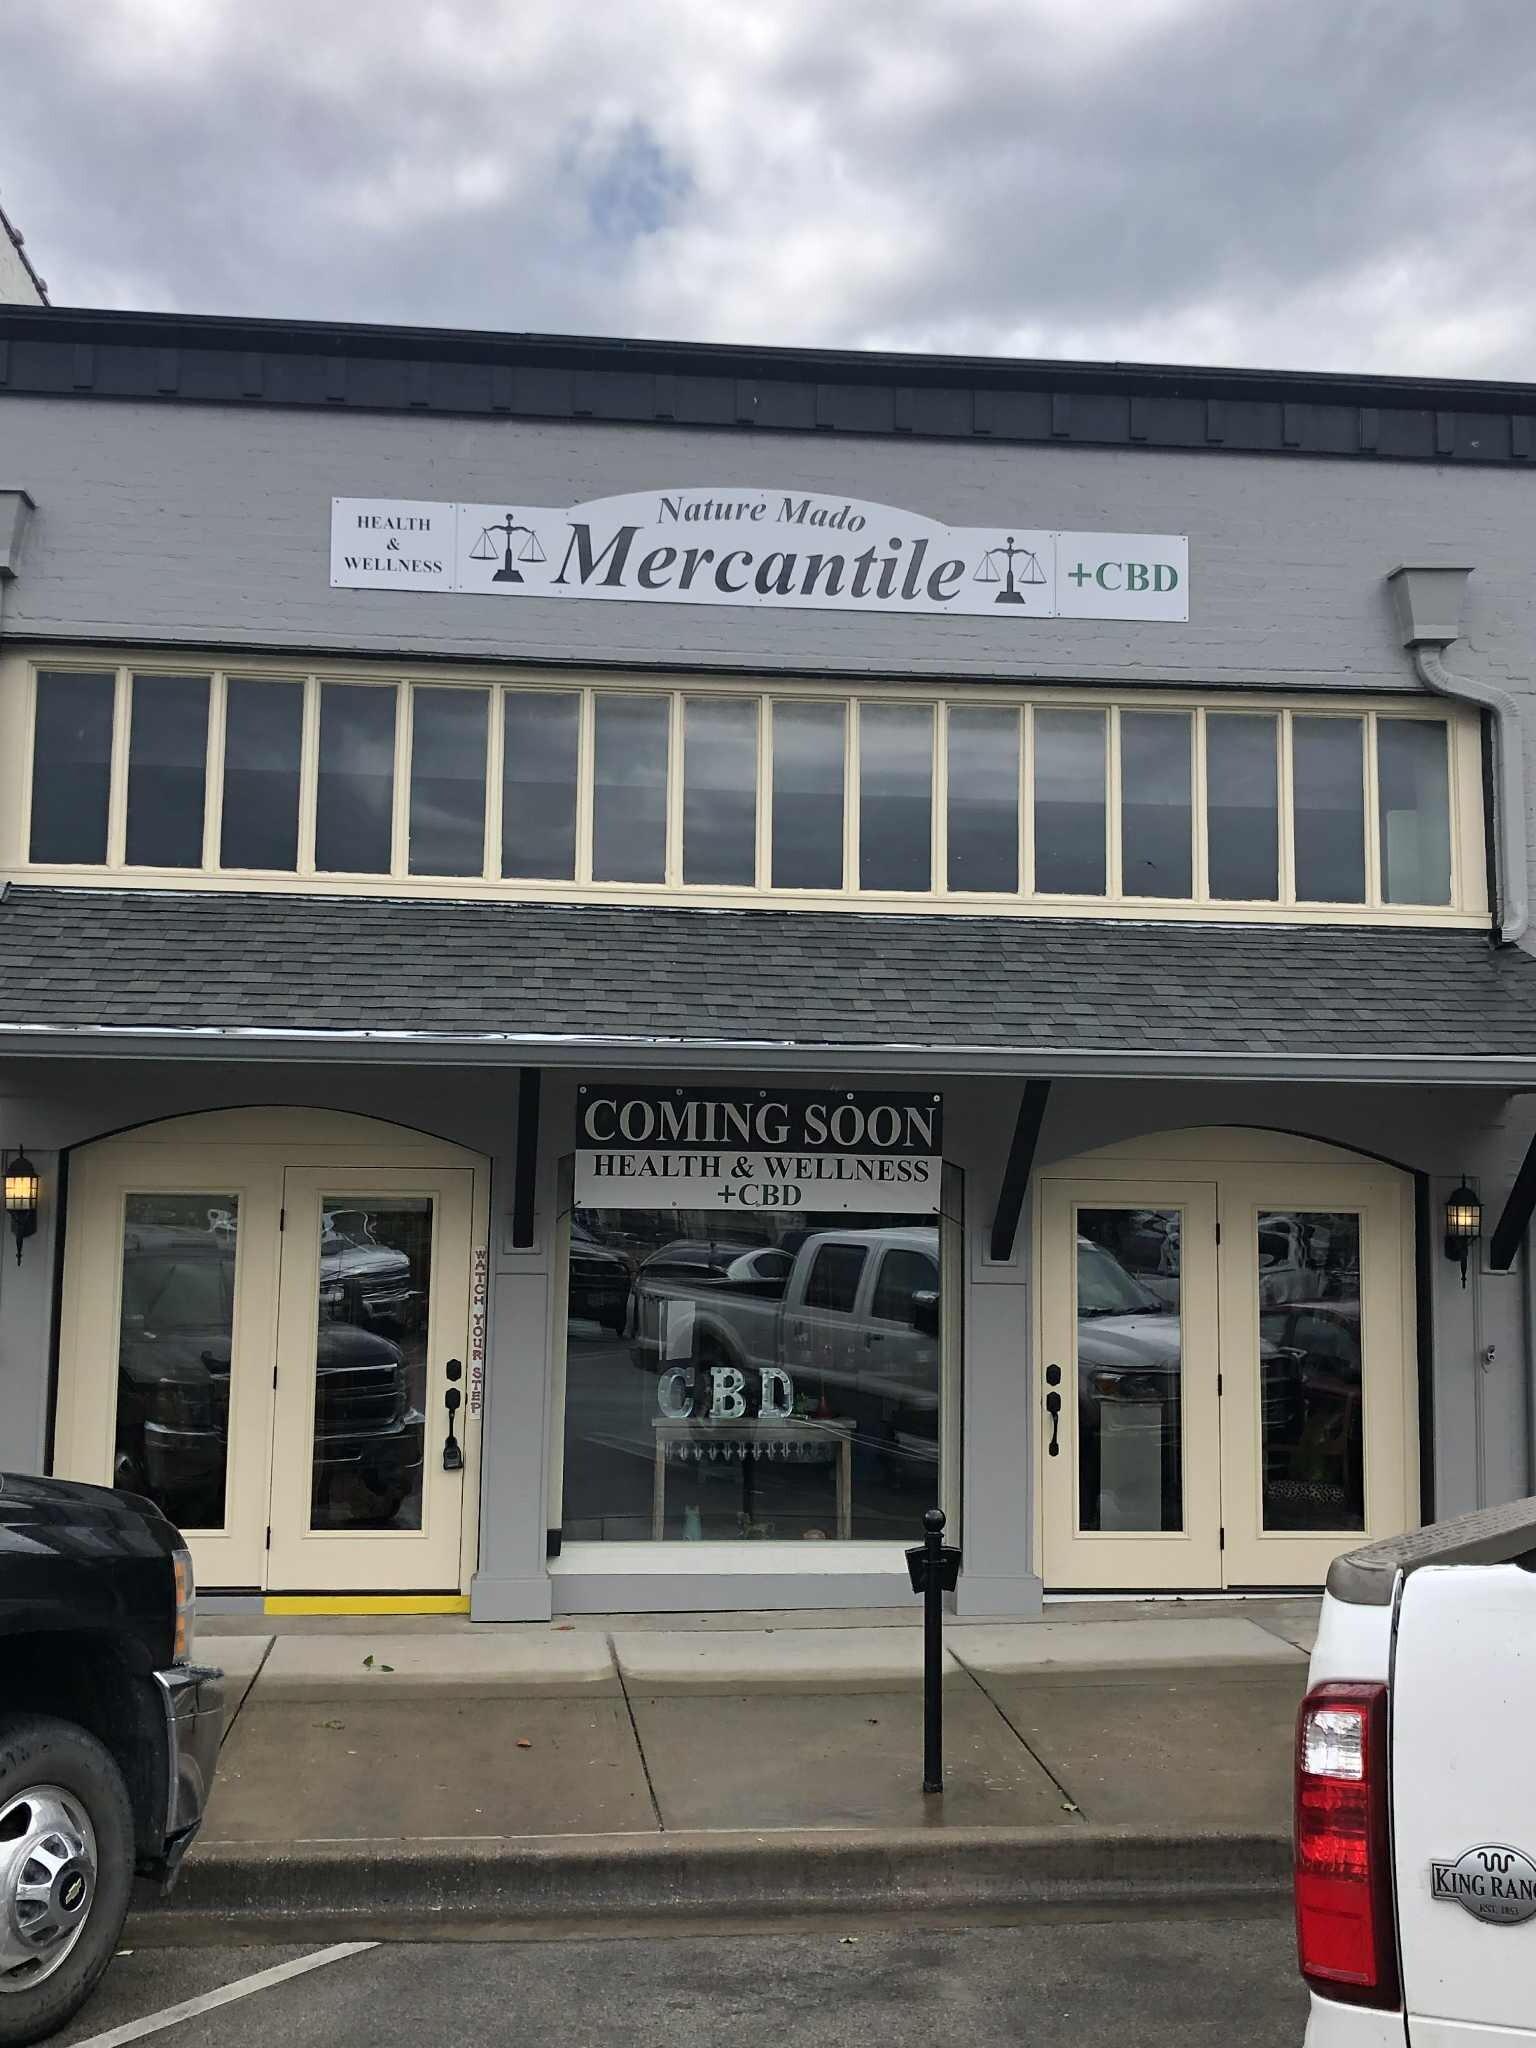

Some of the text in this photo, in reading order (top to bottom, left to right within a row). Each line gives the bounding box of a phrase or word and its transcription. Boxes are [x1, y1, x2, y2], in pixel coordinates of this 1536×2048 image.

[357, 515, 431, 532] HEALTH
[656, 496, 866, 533] Nature Mado
[386, 537, 400, 551] &
[344, 556, 443, 574] WELLNESS
[550, 523, 966, 602] Mercantile
[1067, 561, 1179, 593] +CBD
[584, 1099, 936, 1148] COMING SOON
[592, 1154, 929, 1183] HEALTH & WELLNESS
[717, 1183, 802, 1206] +CBD
[471, 1250, 487, 1414] WATCH YOUR STEP
[1435, 1867, 1536, 1901] KING RAN
